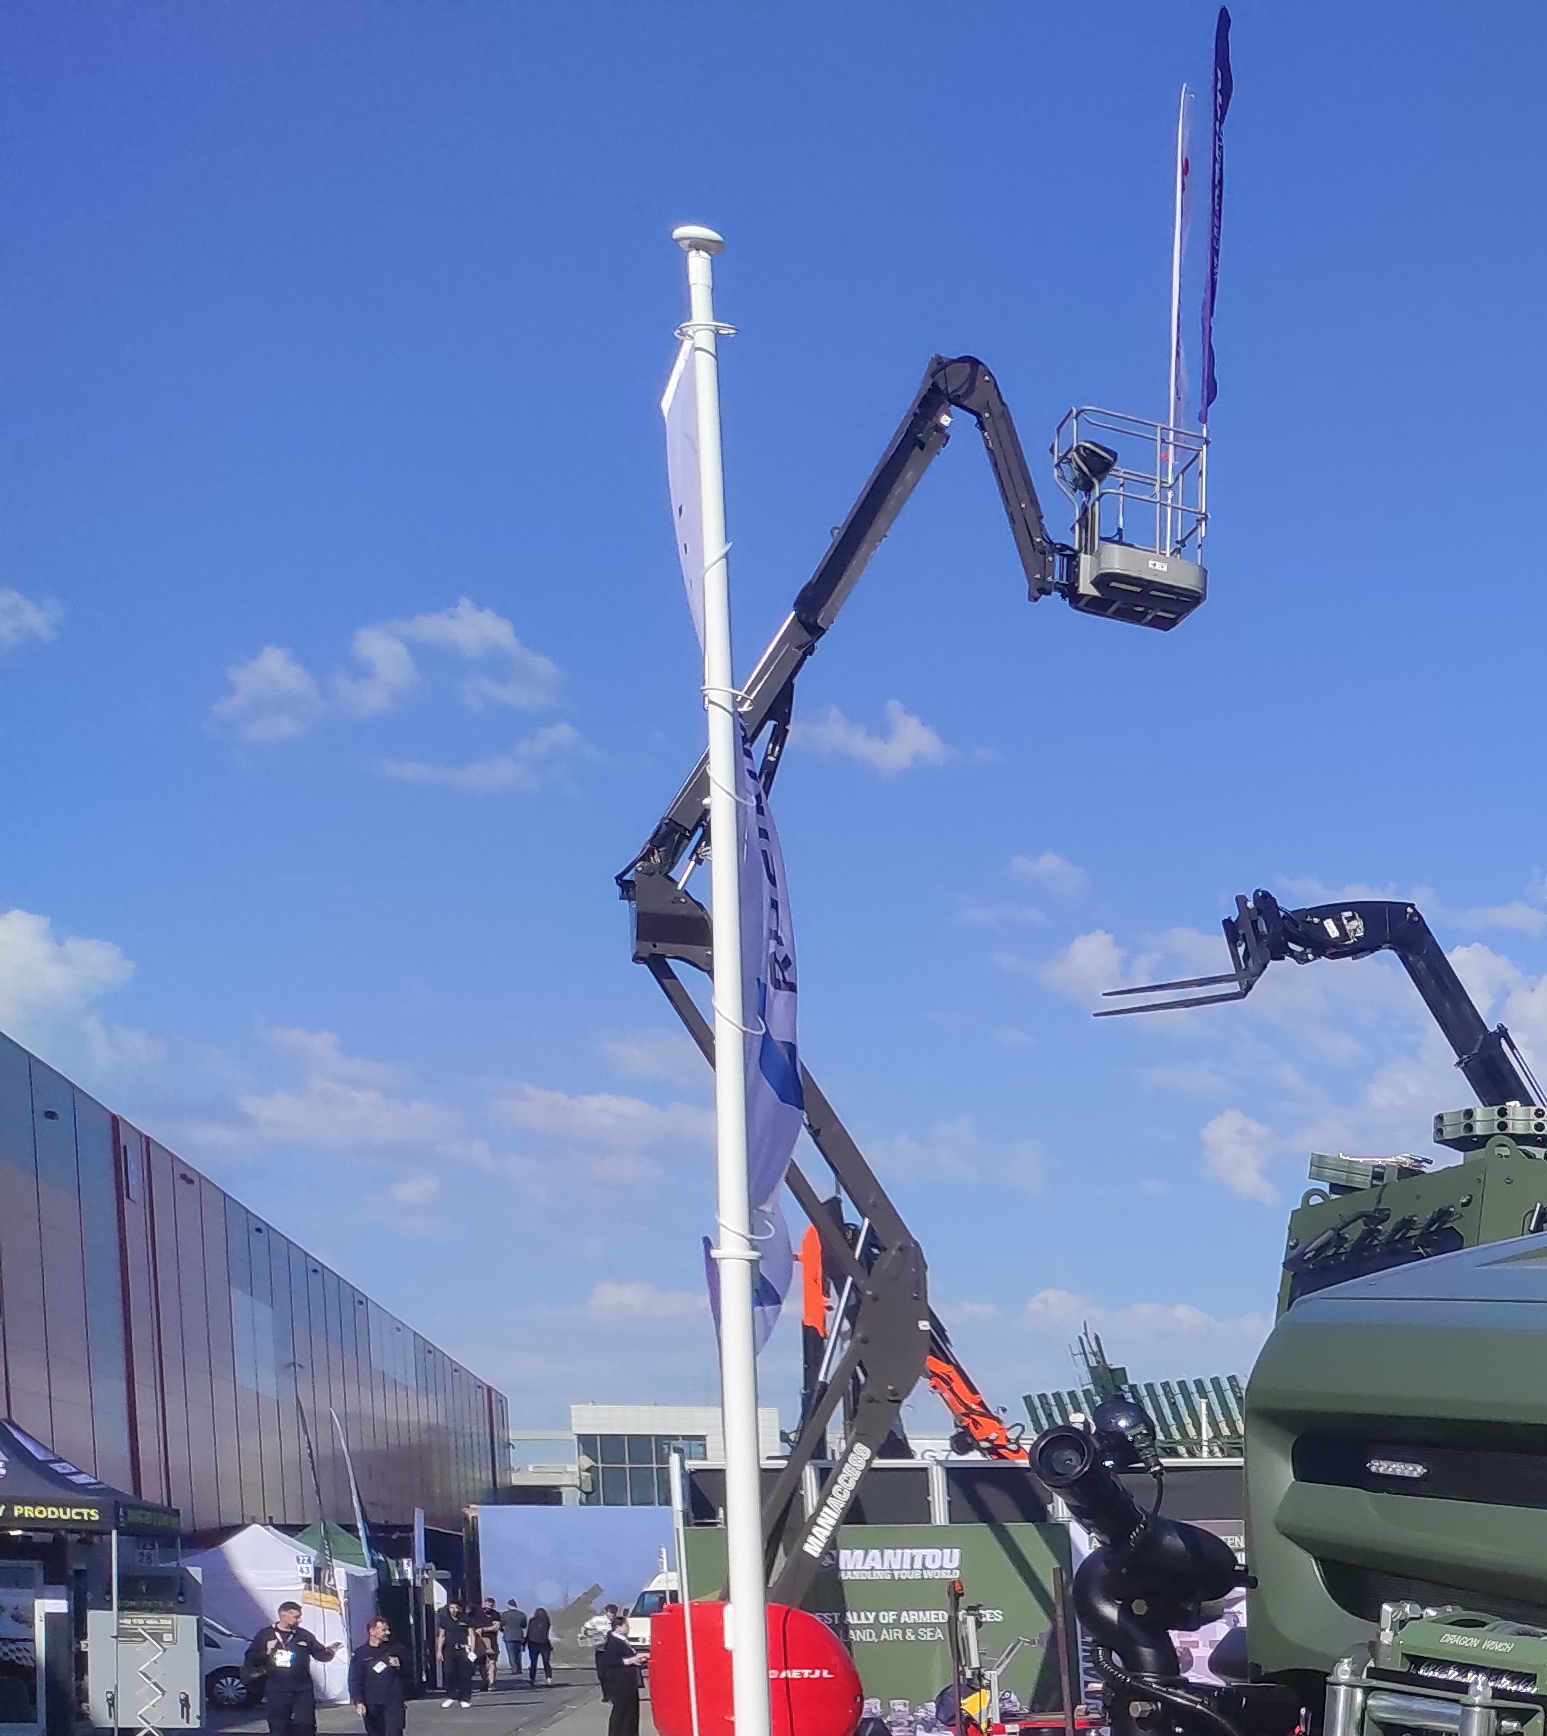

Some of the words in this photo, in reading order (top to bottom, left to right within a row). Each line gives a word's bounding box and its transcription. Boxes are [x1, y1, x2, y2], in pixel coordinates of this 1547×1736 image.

[802, 1441, 871, 1558] MANIACCESS
[13, 1504, 101, 1521] PRODUCTS
[839, 1548, 961, 1570] MANITOU
[878, 1611, 898, 1624] OF
[900, 1610, 949, 1623] ARMED
[880, 1627, 903, 1642] AIR
[905, 1628, 916, 1641] &
[917, 1626, 945, 1641] SEA
[1440, 1633, 1481, 1648] DRAGON
